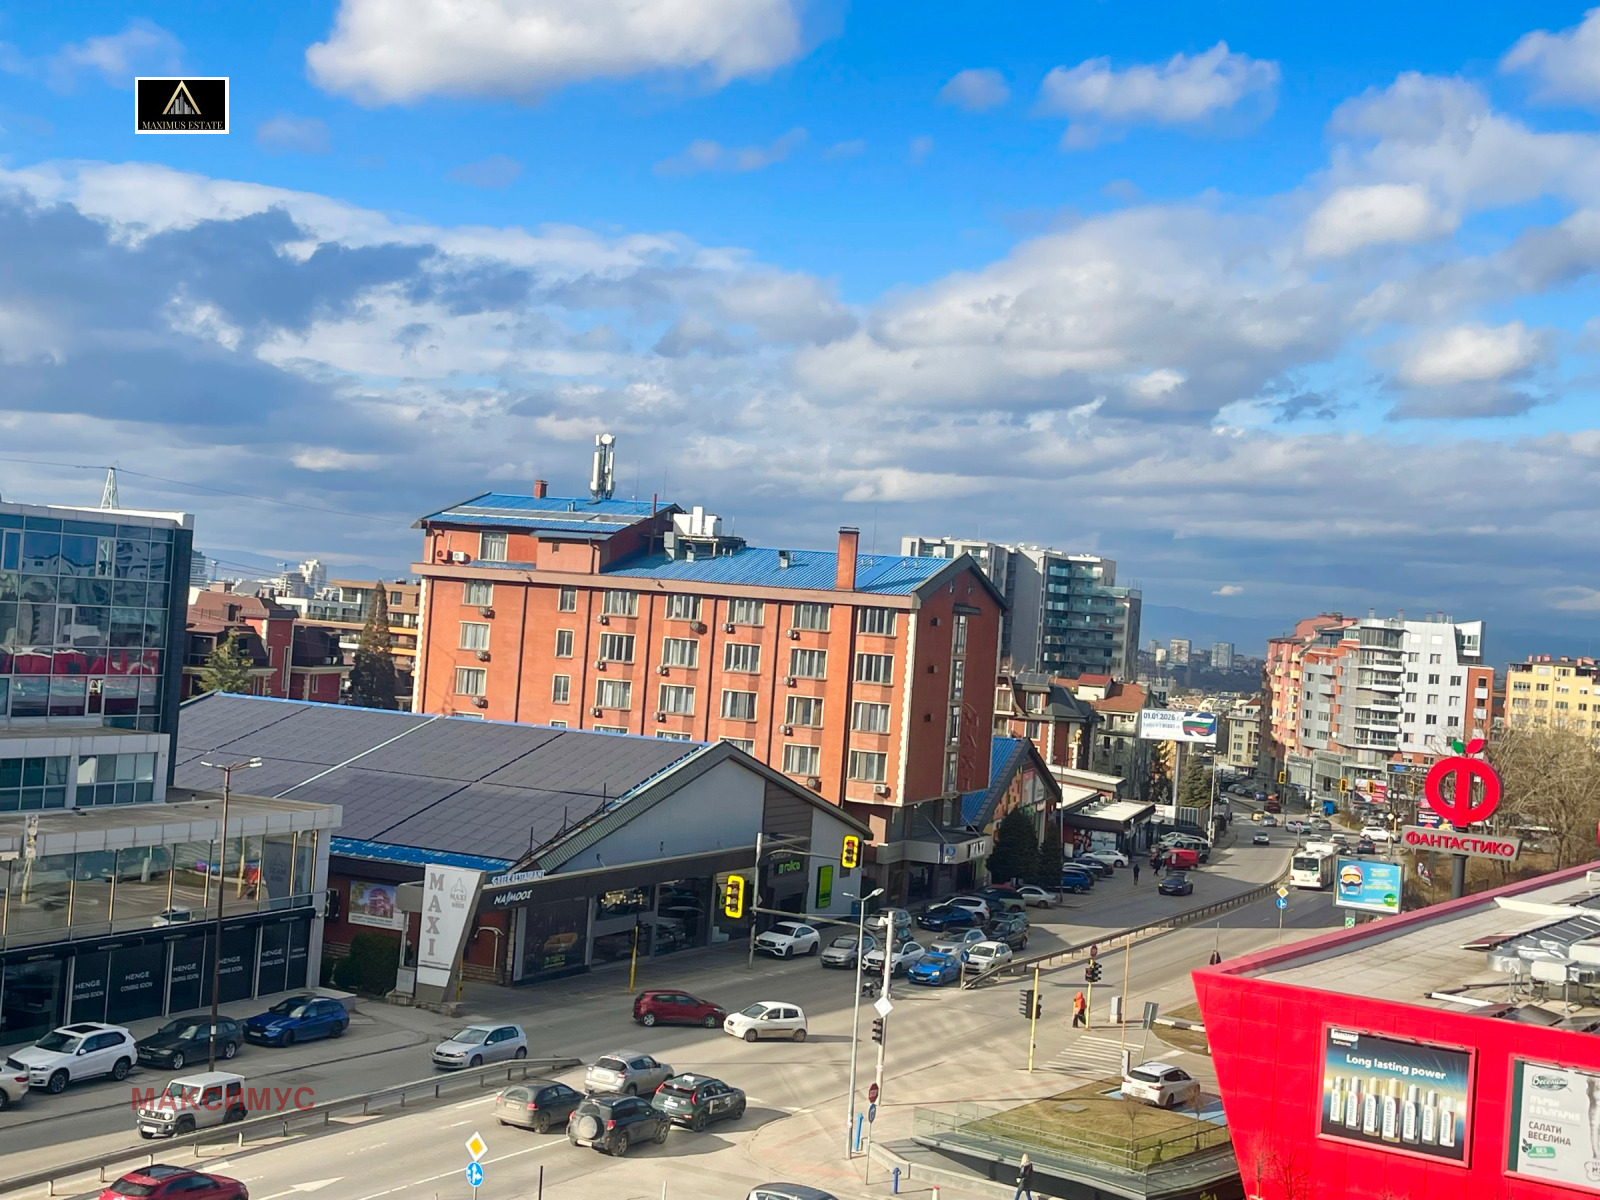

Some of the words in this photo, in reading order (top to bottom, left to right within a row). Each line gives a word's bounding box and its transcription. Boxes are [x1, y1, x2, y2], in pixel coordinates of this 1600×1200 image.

[1405, 831, 1515, 857] ФАНТАСТИКО
[426, 872, 445, 956] MAXI
[262, 949, 283, 957] HENGE
[125, 971, 150, 981] HENGE
[173, 963, 197, 972] HENGE
[75, 980, 101, 989] HENGE
[1346, 1054, 1372, 1068] Long
[1374, 1058, 1410, 1075] lasting
[1411, 1067, 1447, 1080] power
[1365, 1098, 1374, 1127] PHILIPS
[1385, 1101, 1393, 1132] PHILIPS
[1405, 1105, 1413, 1135] PHILIPS
[1528, 1121, 1562, 1134] САЛАТИ
[1528, 1130, 1571, 1146] ВЕСЕЛИНА
